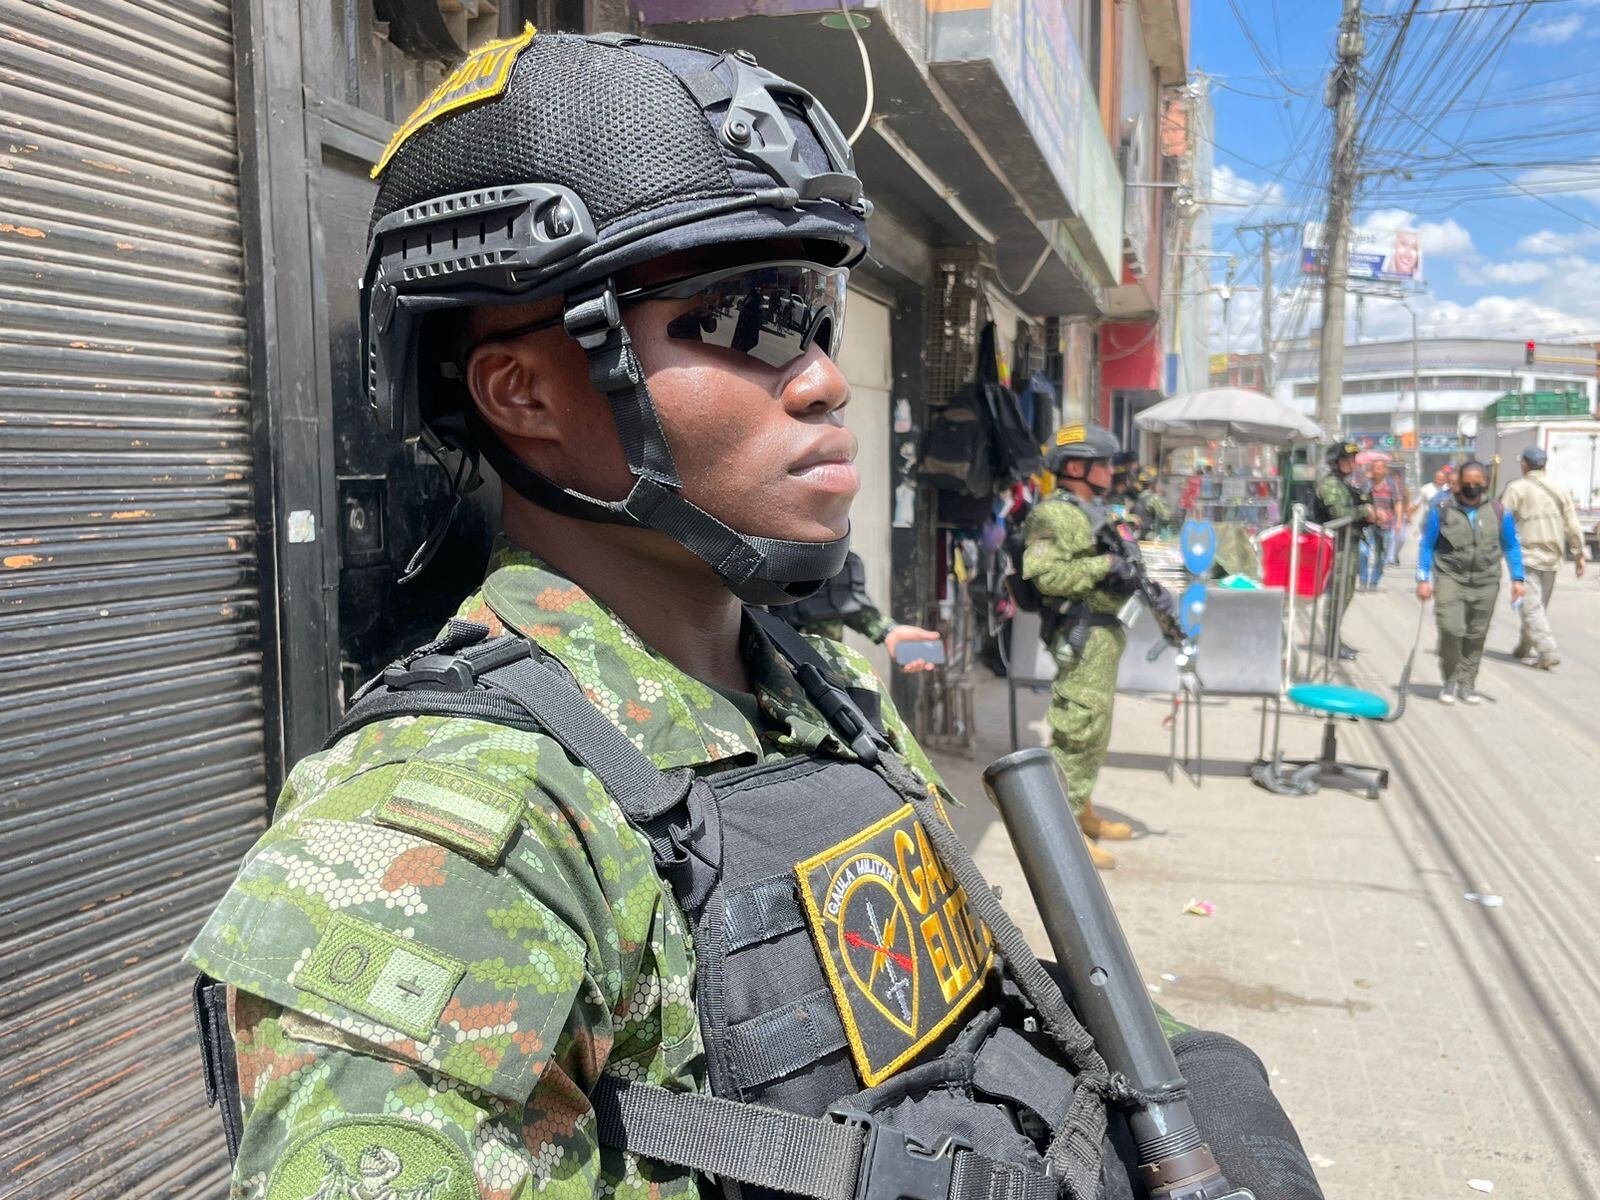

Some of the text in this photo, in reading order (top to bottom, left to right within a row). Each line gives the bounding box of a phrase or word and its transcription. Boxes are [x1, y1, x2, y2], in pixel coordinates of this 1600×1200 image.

[409, 765, 513, 815] COLOMBIA
[828, 858, 894, 915] GAULA MILITAR
